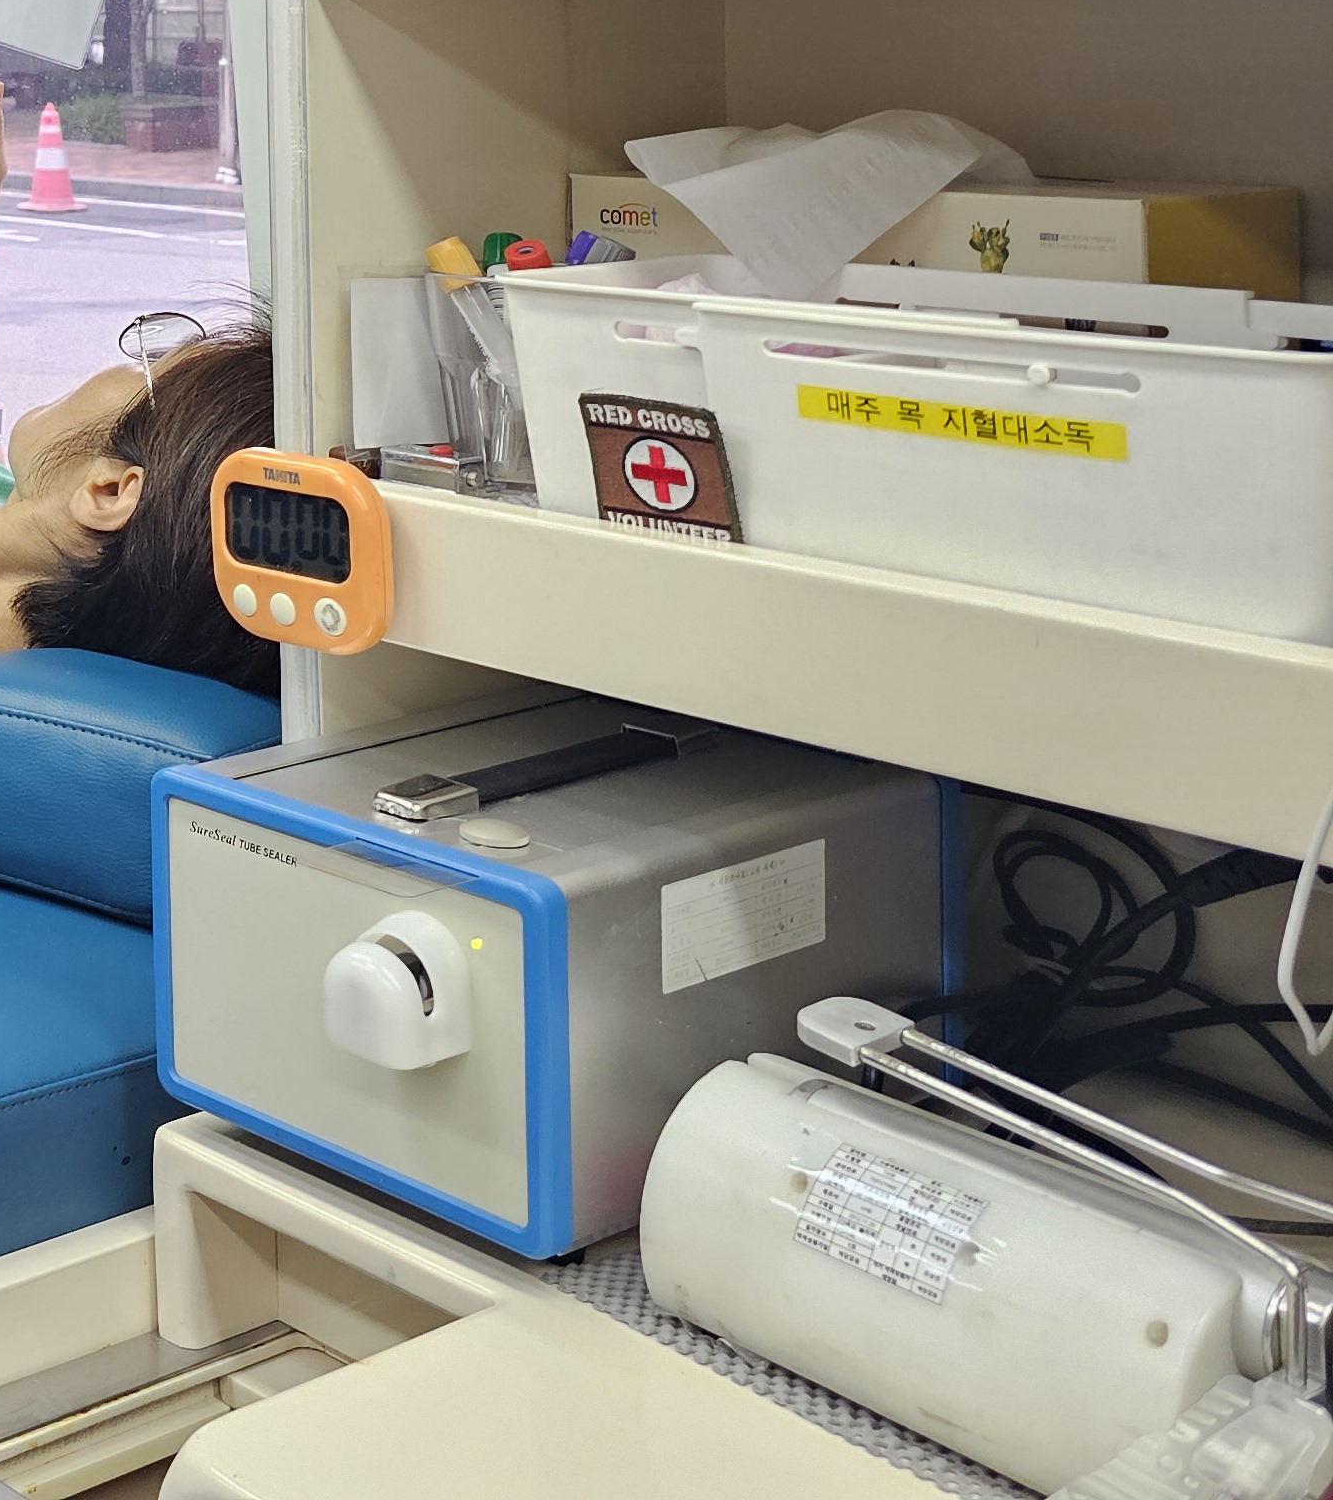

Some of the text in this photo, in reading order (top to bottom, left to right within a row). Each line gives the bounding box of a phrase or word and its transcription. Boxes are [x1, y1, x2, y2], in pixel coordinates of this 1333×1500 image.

[600, 207, 658, 227] comet
[586, 404, 710, 438] RED CROSS
[827, 391, 1094, 452] 매주 목 지혈대소독
[190, 821, 297, 867] SureSeal TUBE SEALER
